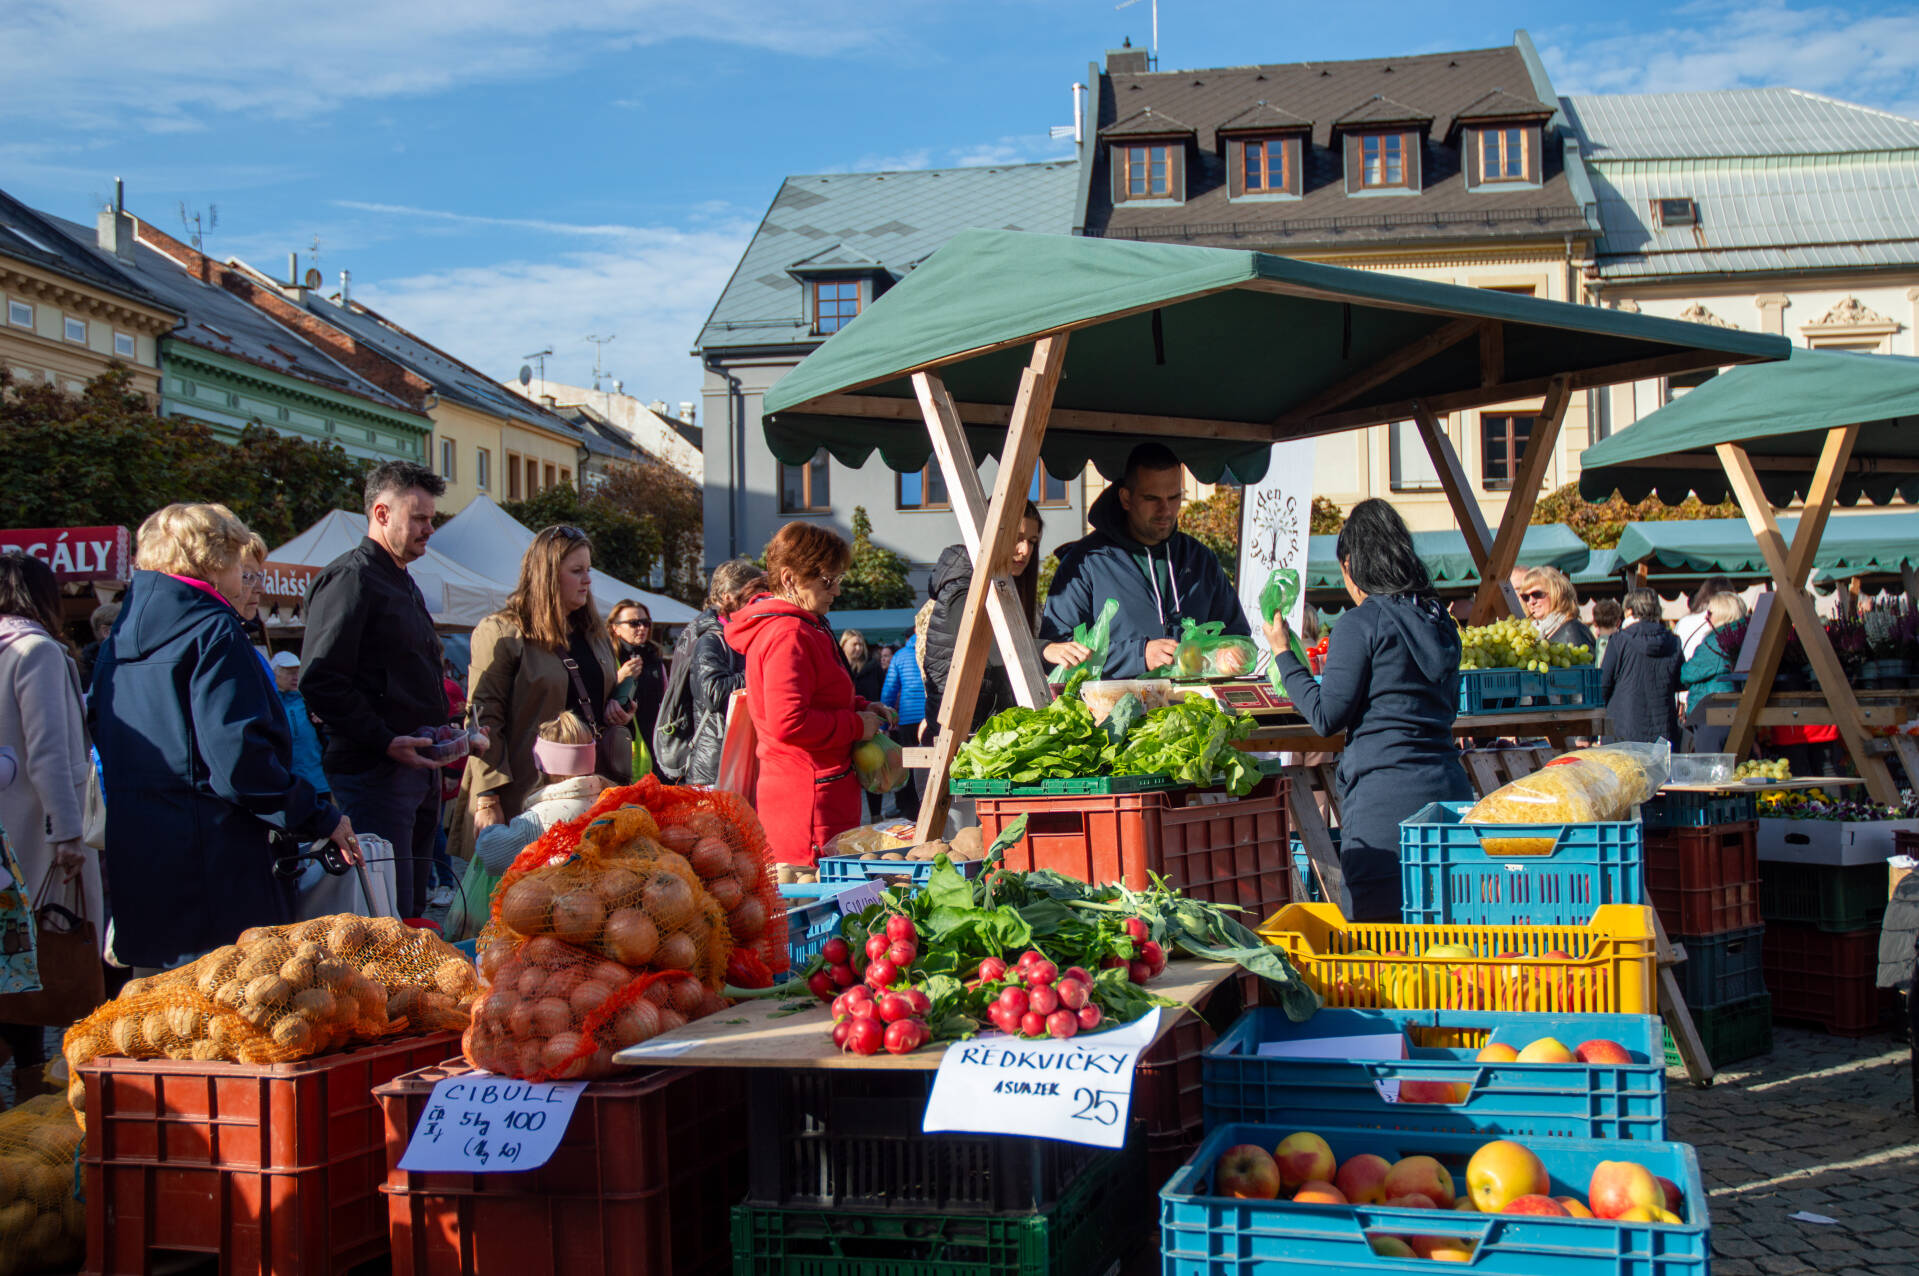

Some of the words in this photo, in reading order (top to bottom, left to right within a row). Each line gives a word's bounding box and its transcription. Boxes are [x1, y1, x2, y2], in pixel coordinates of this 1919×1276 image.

[445, 1084, 573, 1104] CIBULE
[1071, 1087, 1130, 1126] 25
[504, 1110, 546, 1131] 100
